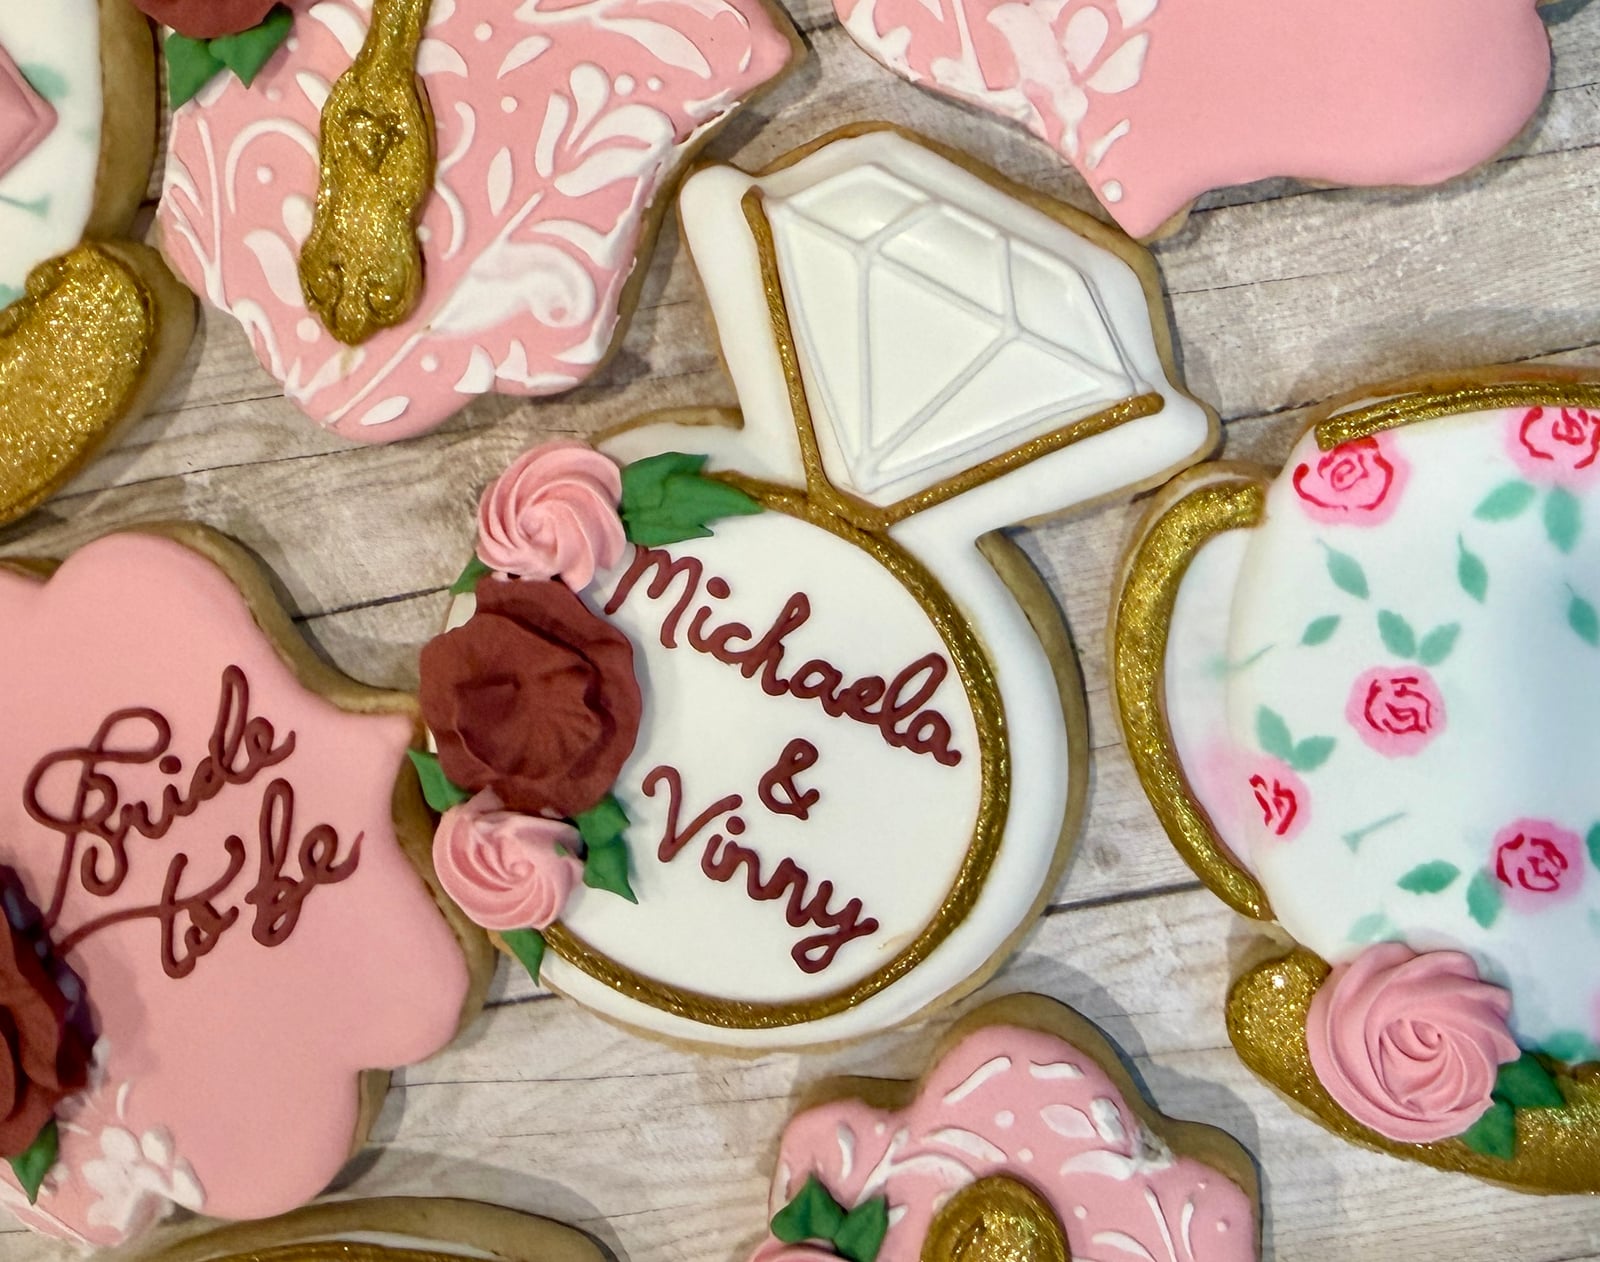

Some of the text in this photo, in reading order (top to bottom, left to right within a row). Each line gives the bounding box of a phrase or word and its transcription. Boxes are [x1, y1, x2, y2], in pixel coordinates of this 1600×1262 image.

[604, 545, 962, 767] Michaela
[23, 664, 296, 926] Bride
[245, 778, 364, 947] be
[642, 765, 879, 974] Vinny
[758, 738, 819, 820] &
